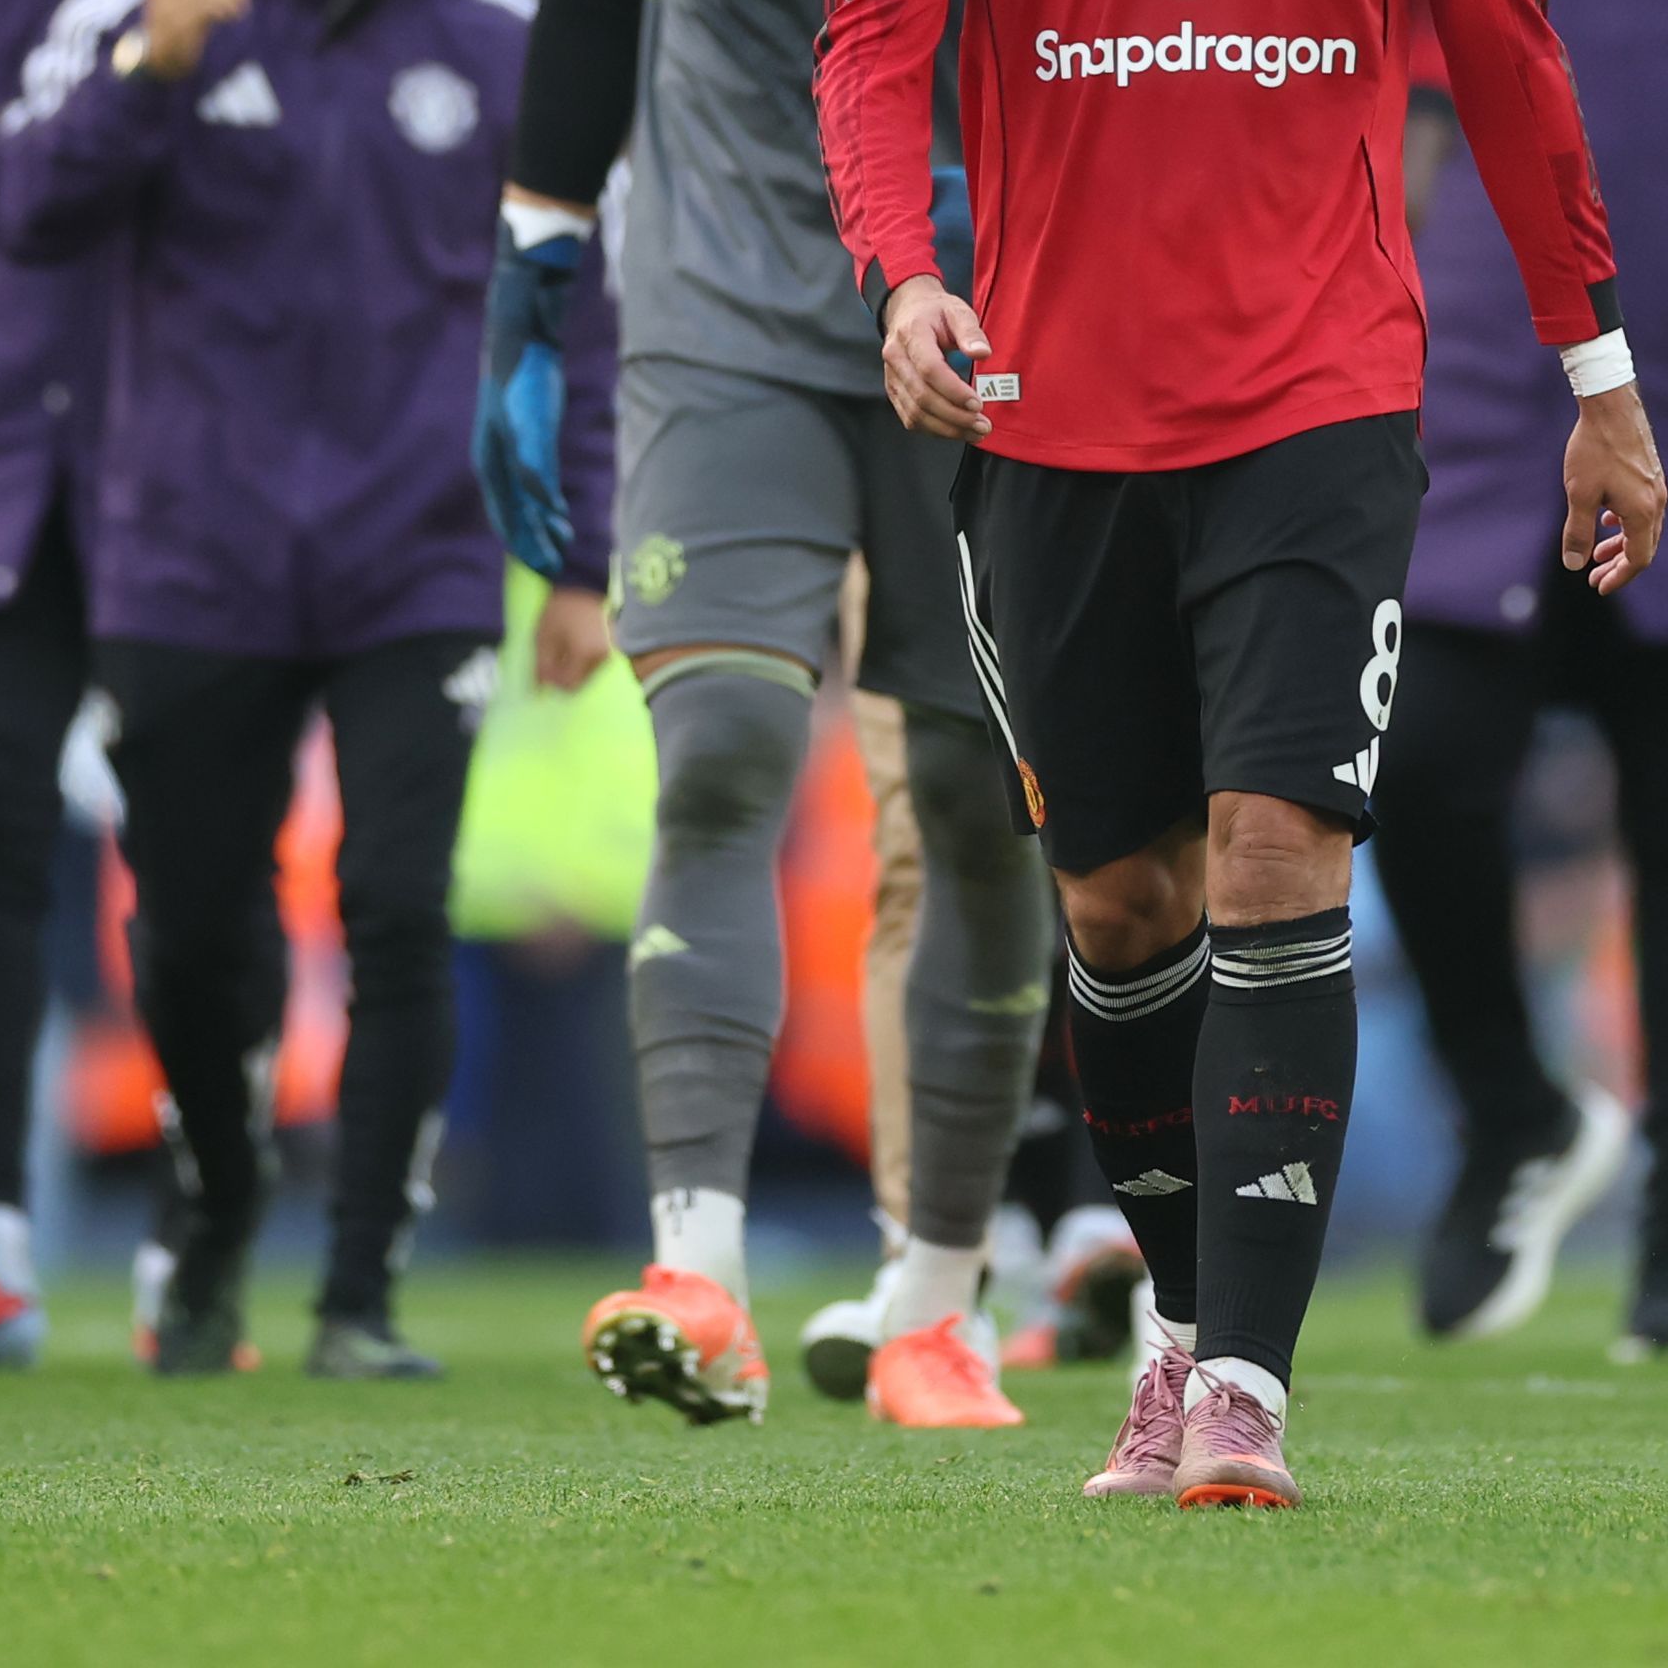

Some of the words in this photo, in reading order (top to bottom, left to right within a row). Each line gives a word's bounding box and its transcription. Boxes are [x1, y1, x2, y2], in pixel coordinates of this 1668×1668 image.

[1035, 20, 1356, 88] Snapdragon
[1359, 598, 1402, 732] 8
[1228, 1095, 1339, 1121] MUFC
